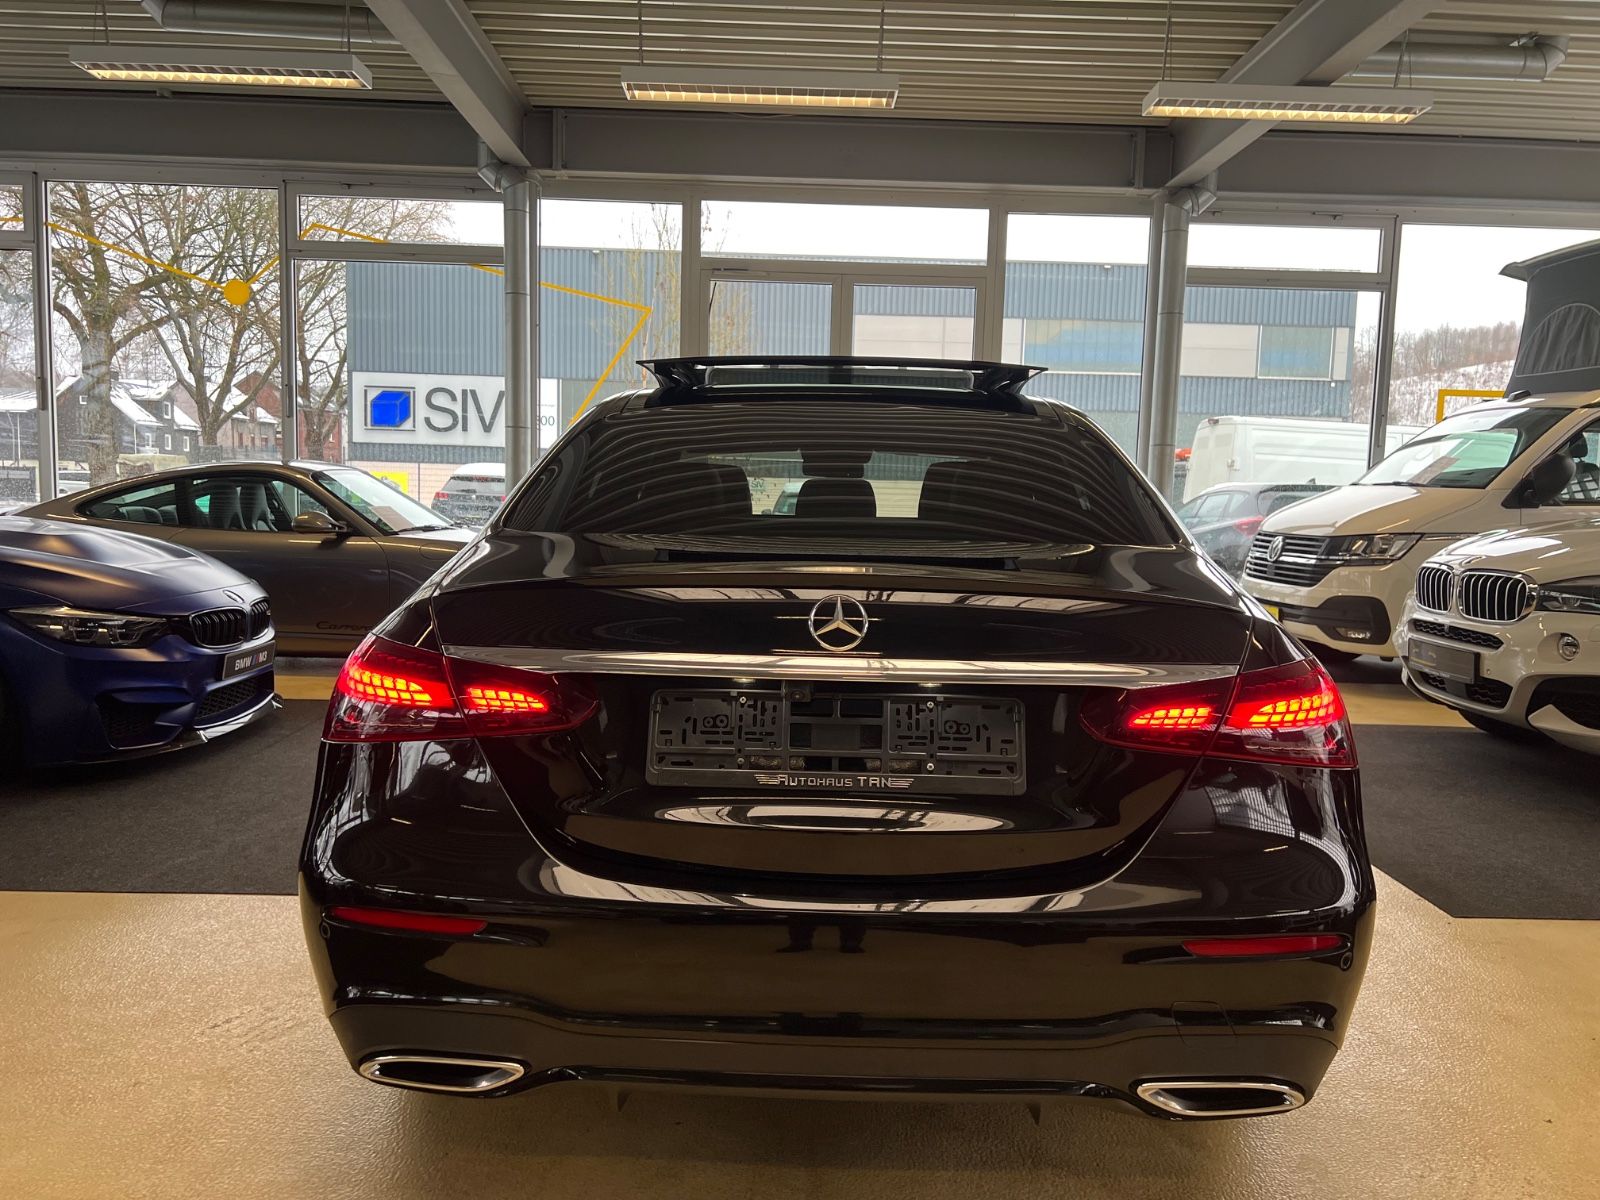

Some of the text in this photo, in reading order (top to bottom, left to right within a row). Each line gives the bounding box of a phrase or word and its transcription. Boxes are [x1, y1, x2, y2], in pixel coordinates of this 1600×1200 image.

[424, 387, 505, 433] SIV
[234, 656, 252, 671] BMW
[857, 776, 892, 788] TAN
